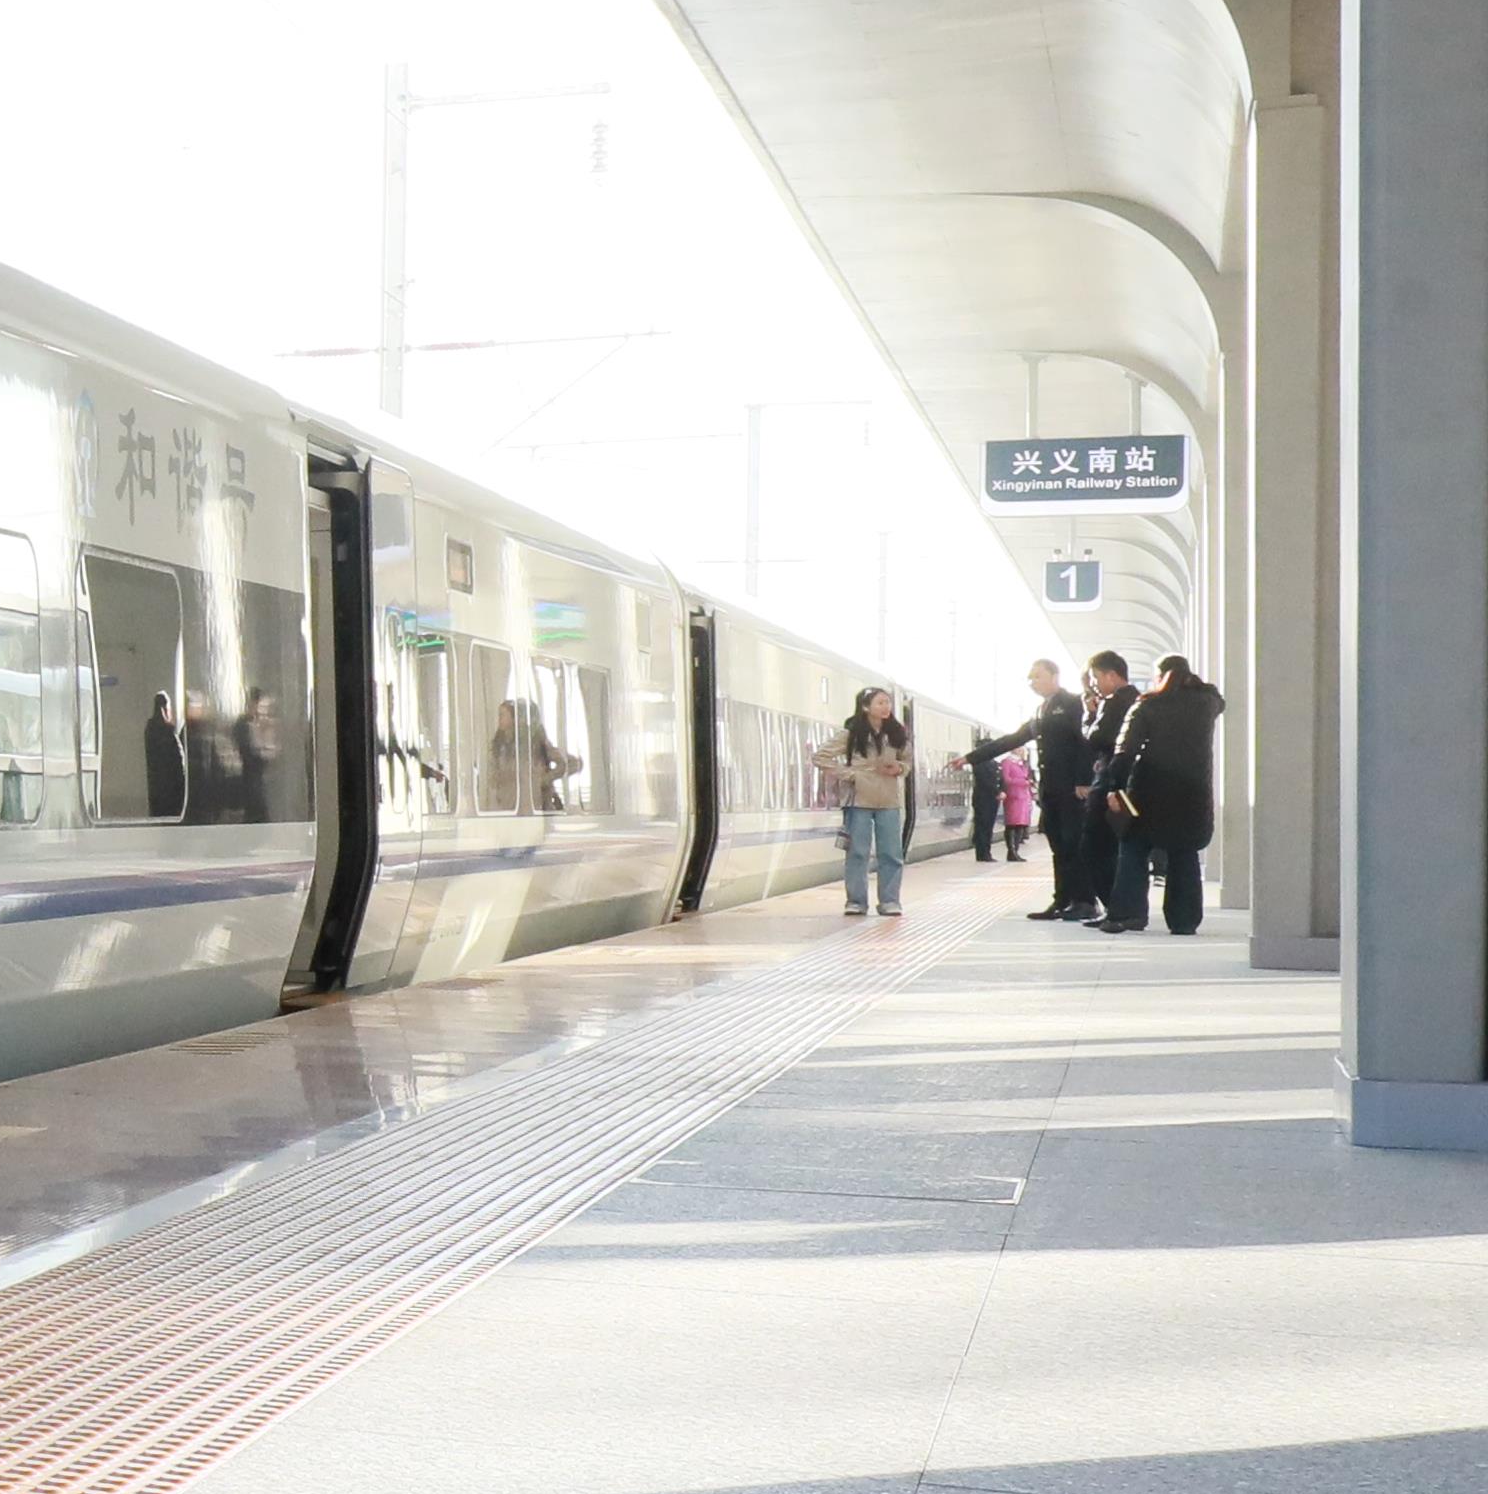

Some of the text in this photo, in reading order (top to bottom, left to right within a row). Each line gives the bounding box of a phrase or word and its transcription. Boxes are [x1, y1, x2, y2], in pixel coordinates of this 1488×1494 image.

[1012, 446, 1156, 475] 兴义南站
[992, 475, 1177, 493] Xingyinan Railway Station
[1059, 565, 1078, 599] 1
